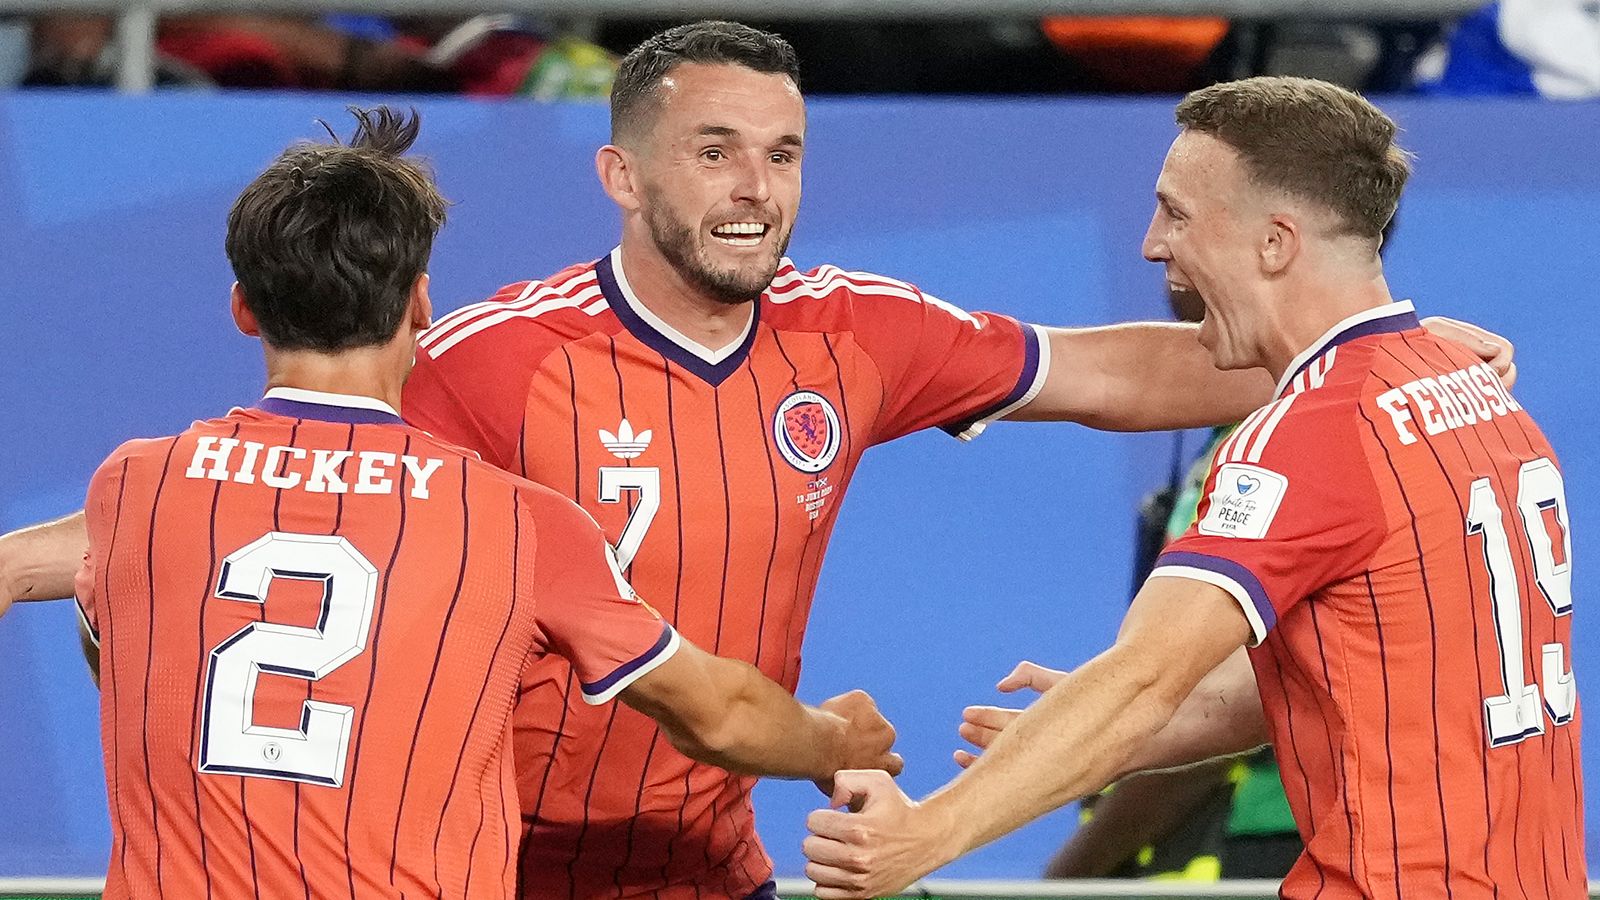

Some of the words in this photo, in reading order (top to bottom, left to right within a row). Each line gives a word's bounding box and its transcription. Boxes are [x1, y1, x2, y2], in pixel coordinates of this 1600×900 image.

[1376, 362, 1523, 445] FERGUSO
[185, 437, 443, 499] HICKEY
[598, 466, 661, 573] 7
[1218, 507, 1251, 526] PEACE
[1466, 457, 1577, 748] 19
[199, 531, 379, 789] 2
